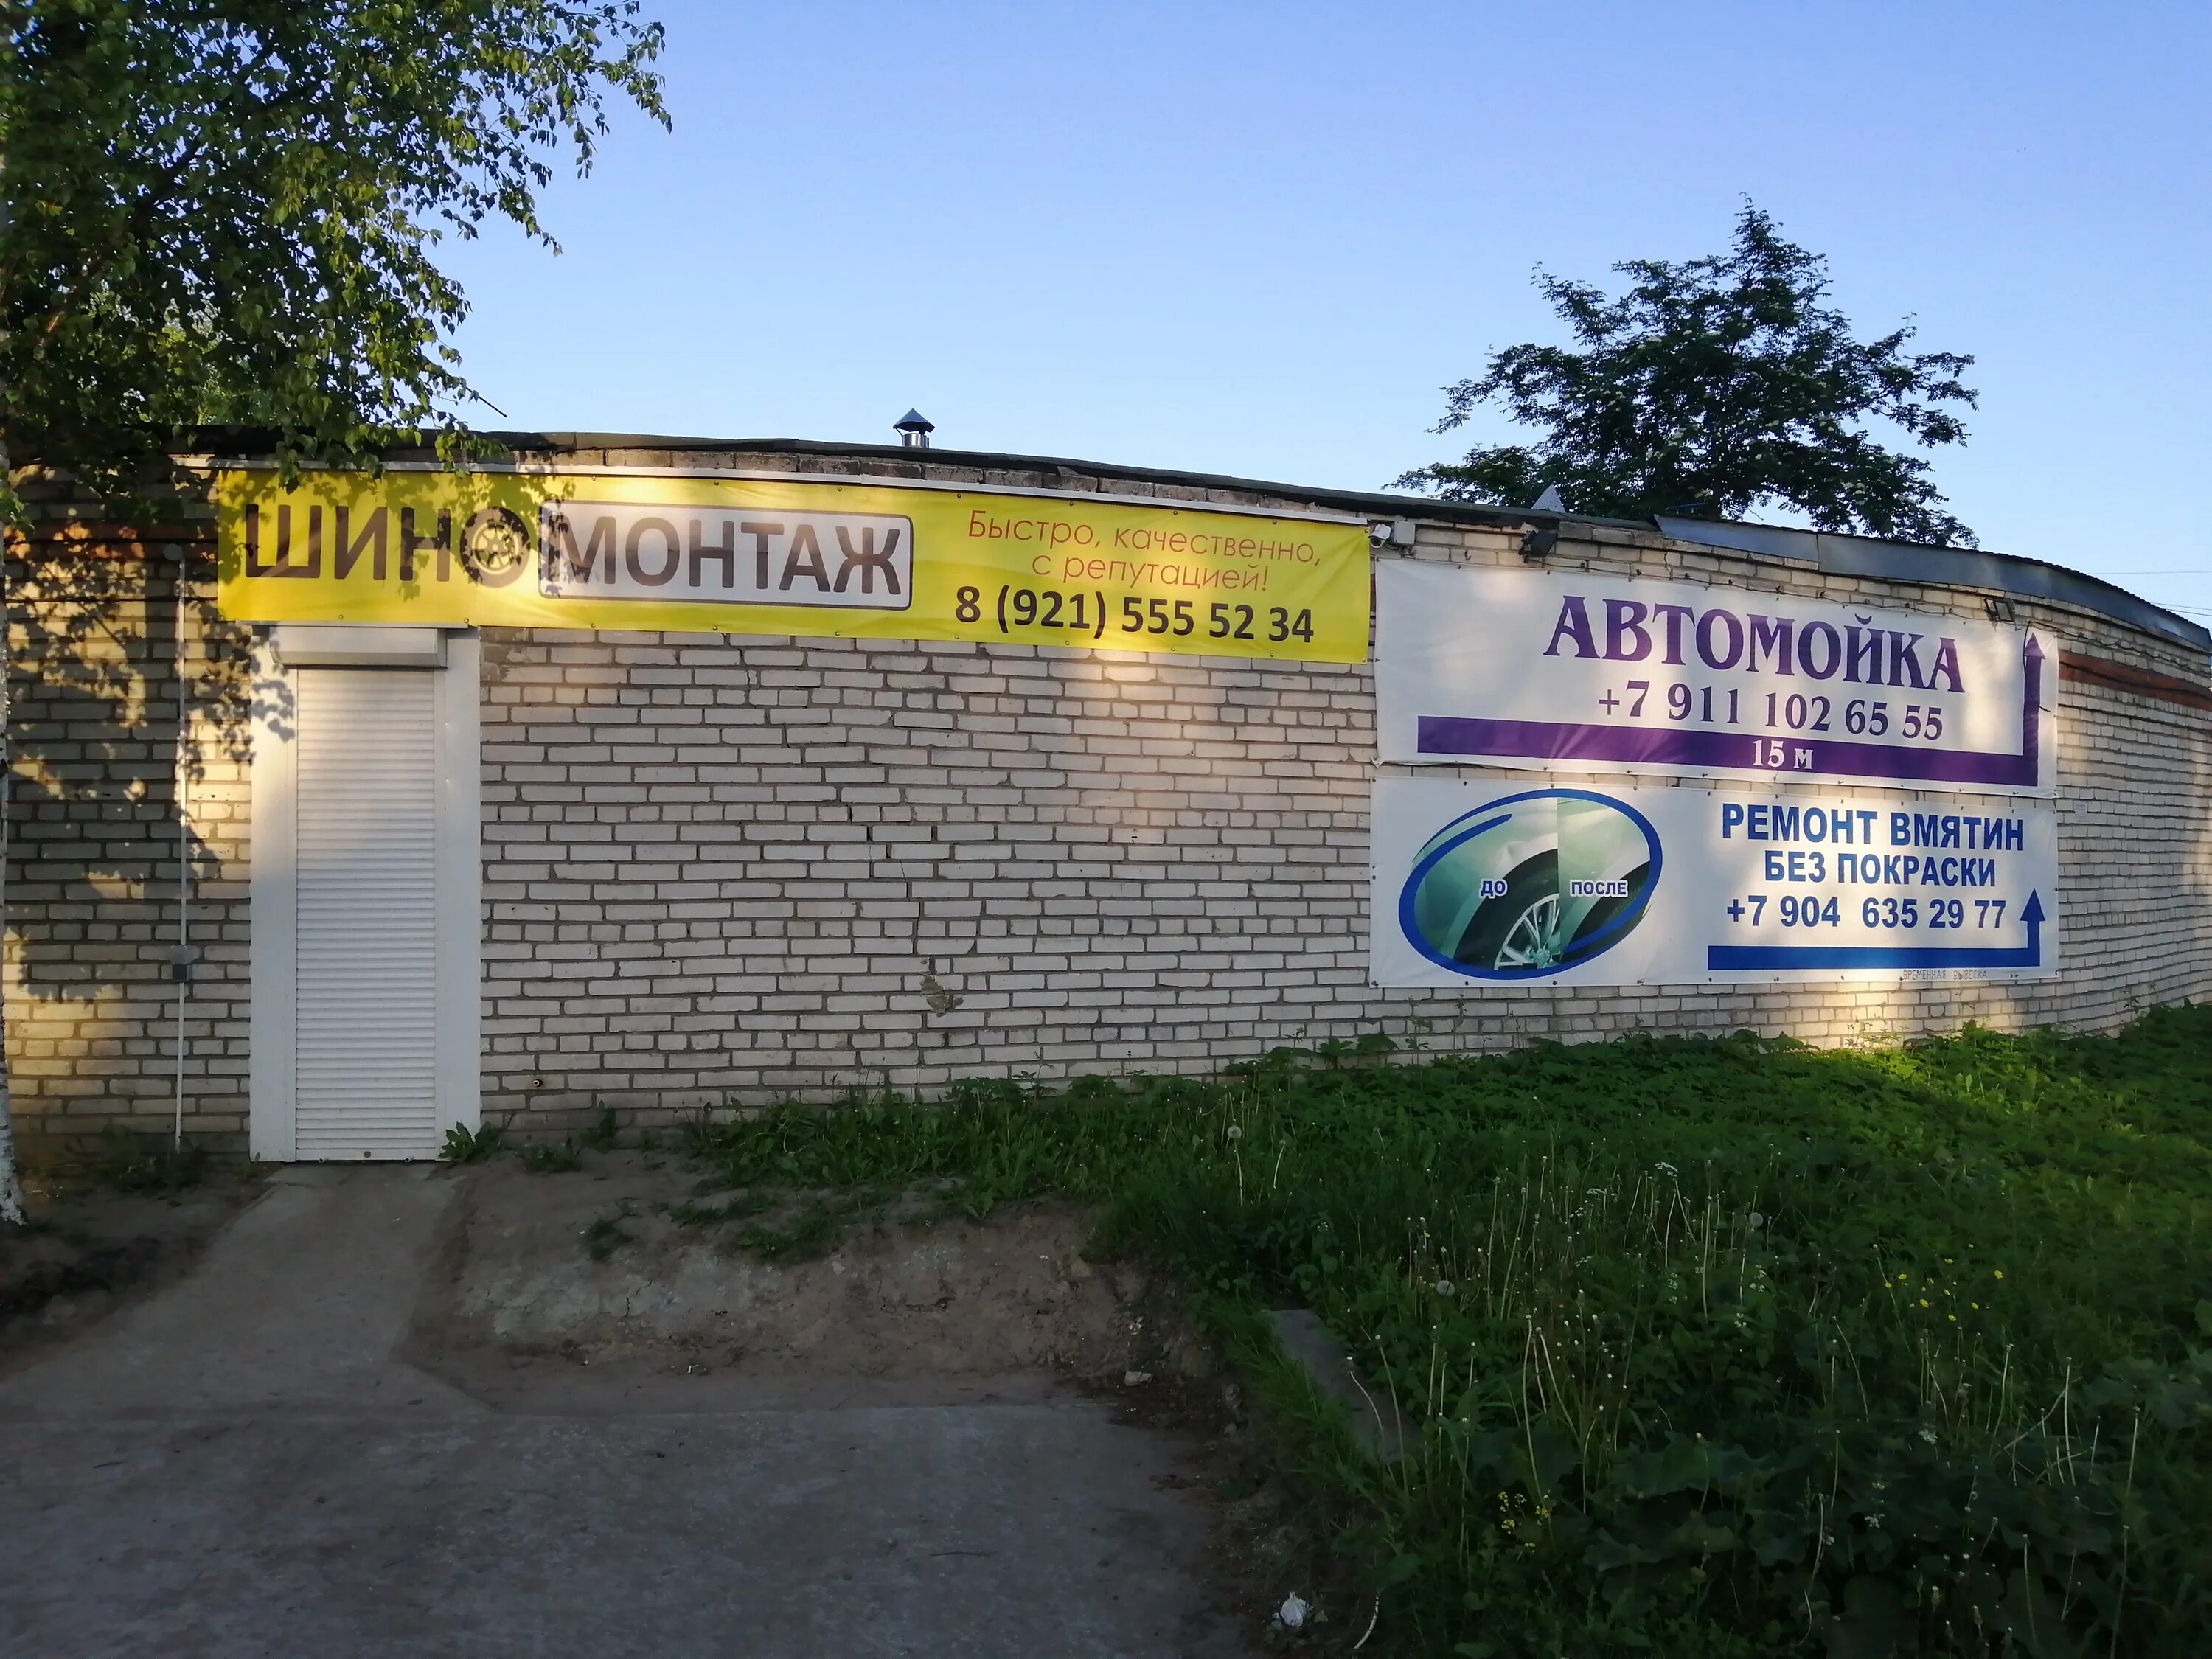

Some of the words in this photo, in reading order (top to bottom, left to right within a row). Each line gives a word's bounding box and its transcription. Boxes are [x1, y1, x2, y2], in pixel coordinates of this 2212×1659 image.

[967, 510, 1100, 549] Быстро,
[1114, 526, 1321, 566] качественно,
[1032, 554, 1051, 576] с
[1062, 554, 1268, 592] репутацией!
[955, 586, 981, 623] 8
[997, 585, 1106, 639] (921)
[1121, 597, 1194, 636] 555
[1208, 603, 1254, 640] 52
[1267, 607, 1314, 643] 34
[1543, 595, 1966, 693] АВТОМОЙКА
[1599, 679, 1648, 717] +7
[1668, 683, 1739, 724] 911
[1765, 692, 1832, 731] 102
[1844, 699, 1889, 738] 65
[1902, 706, 1943, 740] 55
[1753, 740, 1784, 768] 15
[1722, 803, 1878, 845] РЕМОНТ
[1891, 813, 2023, 851] ВМЯТИН
[1764, 850, 1826, 883] БЕЗ
[1837, 853, 1996, 887] ПОКРАСКИ
[1480, 880, 1506, 897] ДО
[1571, 880, 1627, 896] ПОСЛЕ
[1727, 894, 1767, 928] +7
[1780, 897, 1840, 929] 904
[1861, 898, 1917, 929] 635
[1928, 900, 1964, 929] 29
[1975, 900, 2006, 929] 77
